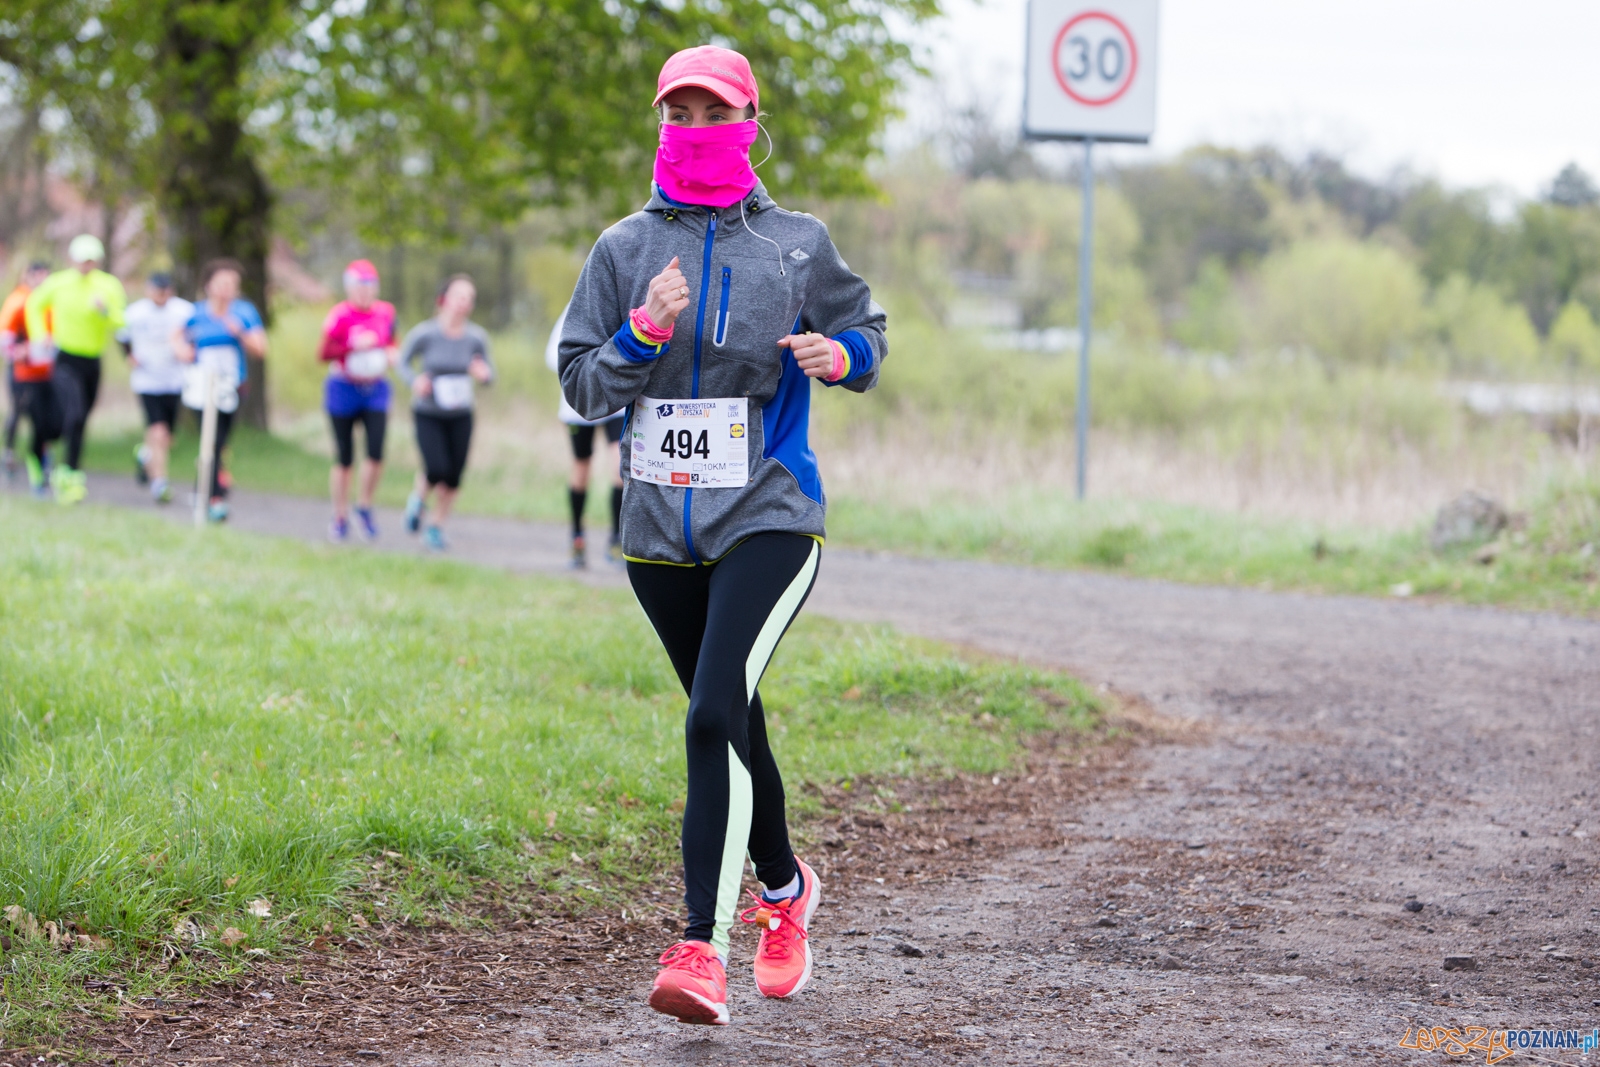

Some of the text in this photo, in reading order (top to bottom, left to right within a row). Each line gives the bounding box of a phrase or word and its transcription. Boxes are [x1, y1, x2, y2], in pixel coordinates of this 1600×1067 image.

[1066, 35, 1124, 81] 30
[676, 402, 716, 410] UNIWERSYTECKA
[661, 429, 710, 459] 494
[647, 460, 664, 469] 5KM
[703, 463, 727, 471] 10KM
